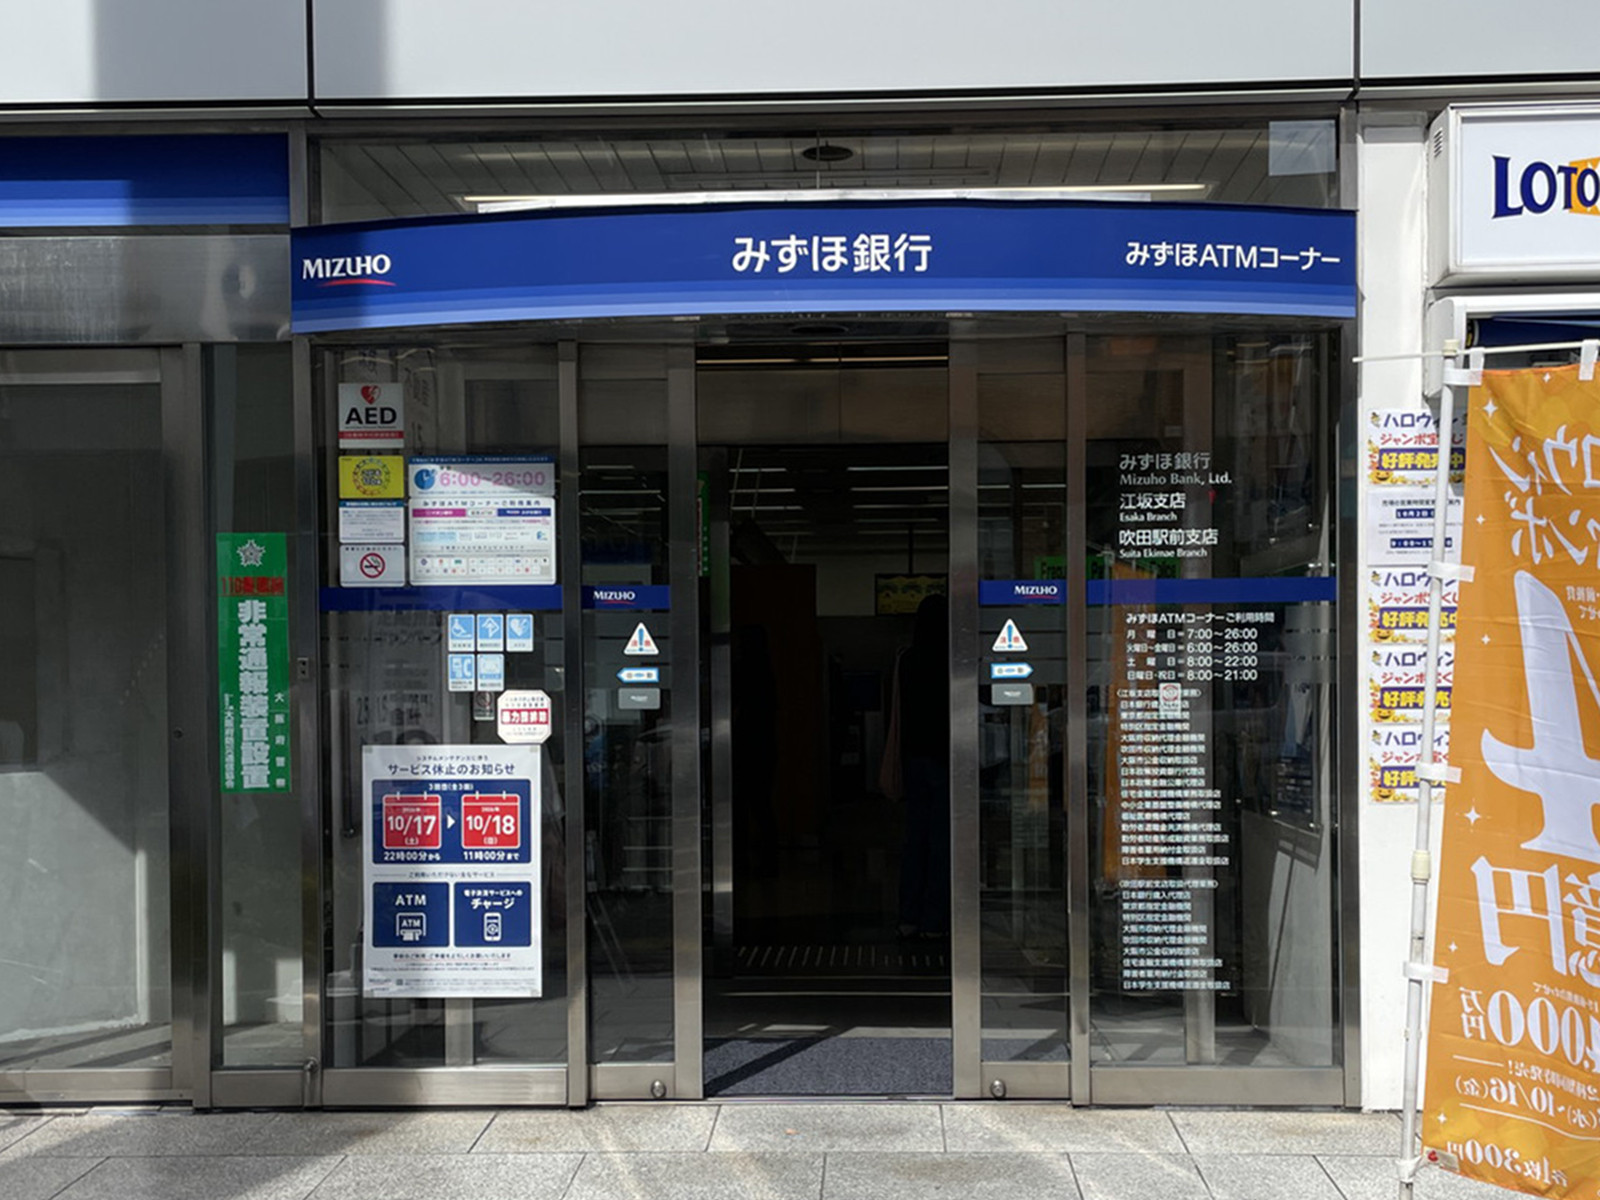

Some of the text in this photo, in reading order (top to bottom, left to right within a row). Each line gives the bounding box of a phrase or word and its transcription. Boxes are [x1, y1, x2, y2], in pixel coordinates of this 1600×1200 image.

[1492, 155, 1600, 219] LOTO
[731, 233, 933, 275] みずほ銀行
[1124, 241, 1341, 270] みずほATMコーナー
[302, 253, 391, 280] MIZUHO
[345, 407, 397, 425] AED
[1380, 433, 1463, 446] ジャンボ宝じ
[1119, 453, 1211, 470] みずほ銀行
[1119, 472, 1232, 486] Mizuho Bank, Ltd.
[1119, 493, 1187, 509] 江坂支店
[1119, 512, 1178, 522] Esaka Branch
[1119, 529, 1219, 545] 吹田駅前支店
[1119, 549, 1208, 558] Suita Ekimae Branch
[1384, 571, 1457, 587] ハロウン
[593, 590, 636, 601] MIZUHO
[1014, 585, 1058, 595] MIZUHO
[1380, 592, 1460, 605] ジャンボく
[1125, 612, 1275, 624] みずほATMコーナーご利用時間
[237, 599, 270, 788] 非常通報装置設置
[388, 763, 516, 776] サービス休止のお知らせ
[387, 815, 516, 836] 10/17 10/18
[404, 837, 419, 846] (土)
[383, 850, 520, 861] 22時00分から 11時00分まで
[395, 894, 427, 906] ATM
[470, 898, 515, 909] チャージ
[401, 918, 421, 928] ATM
